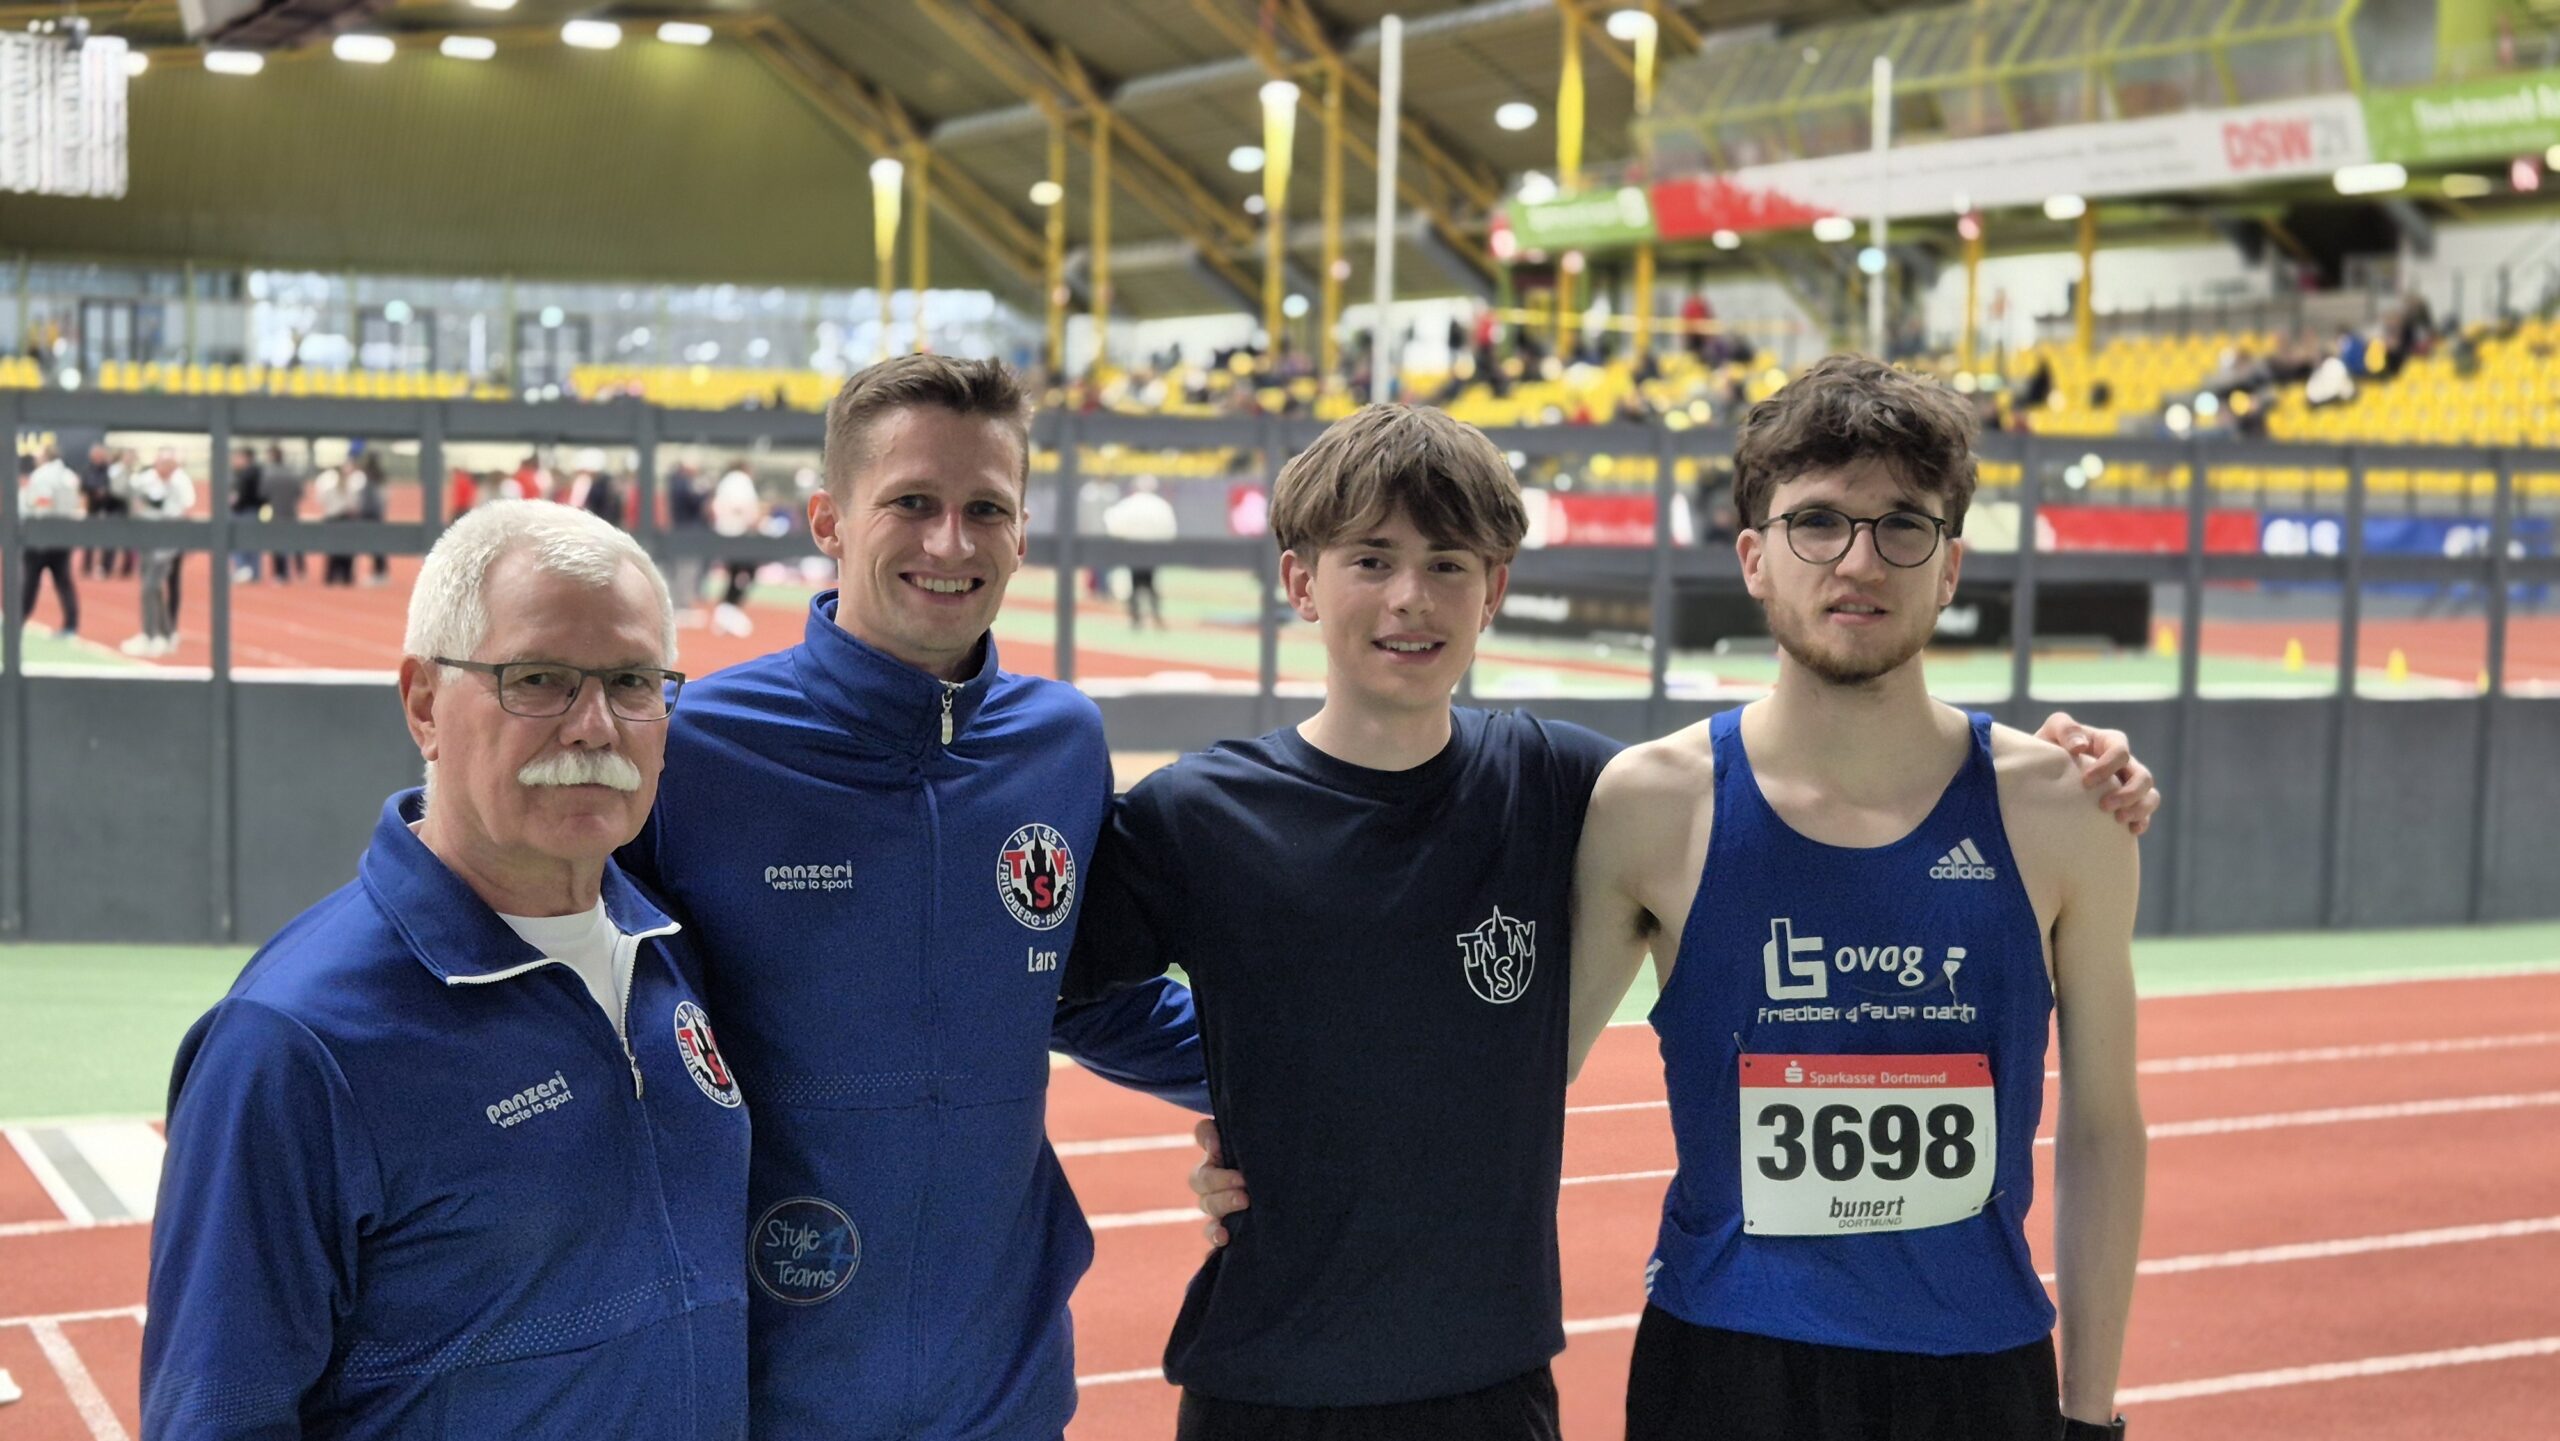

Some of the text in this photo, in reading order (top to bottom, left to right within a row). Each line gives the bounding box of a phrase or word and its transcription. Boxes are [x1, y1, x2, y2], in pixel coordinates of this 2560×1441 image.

[764, 860, 852, 883] panzeri
[1929, 863, 1996, 880] adidas
[772, 879, 853, 892] veste lo sport
[1028, 946, 1057, 972] Lars
[1834, 946, 1924, 986] ovag
[1809, 1071, 1876, 1085] Sparkasse
[1880, 1071, 1947, 1084] Dortmund
[486, 1070, 568, 1124] panzeri
[498, 1090, 574, 1129] veste lo sport
[1756, 1103, 1976, 1181] 3698
[1829, 1195, 1905, 1218] bunert
[1838, 1217, 1902, 1228] DORTMUND
[765, 1219, 820, 1260] Style
[773, 1260, 837, 1289] Teams
